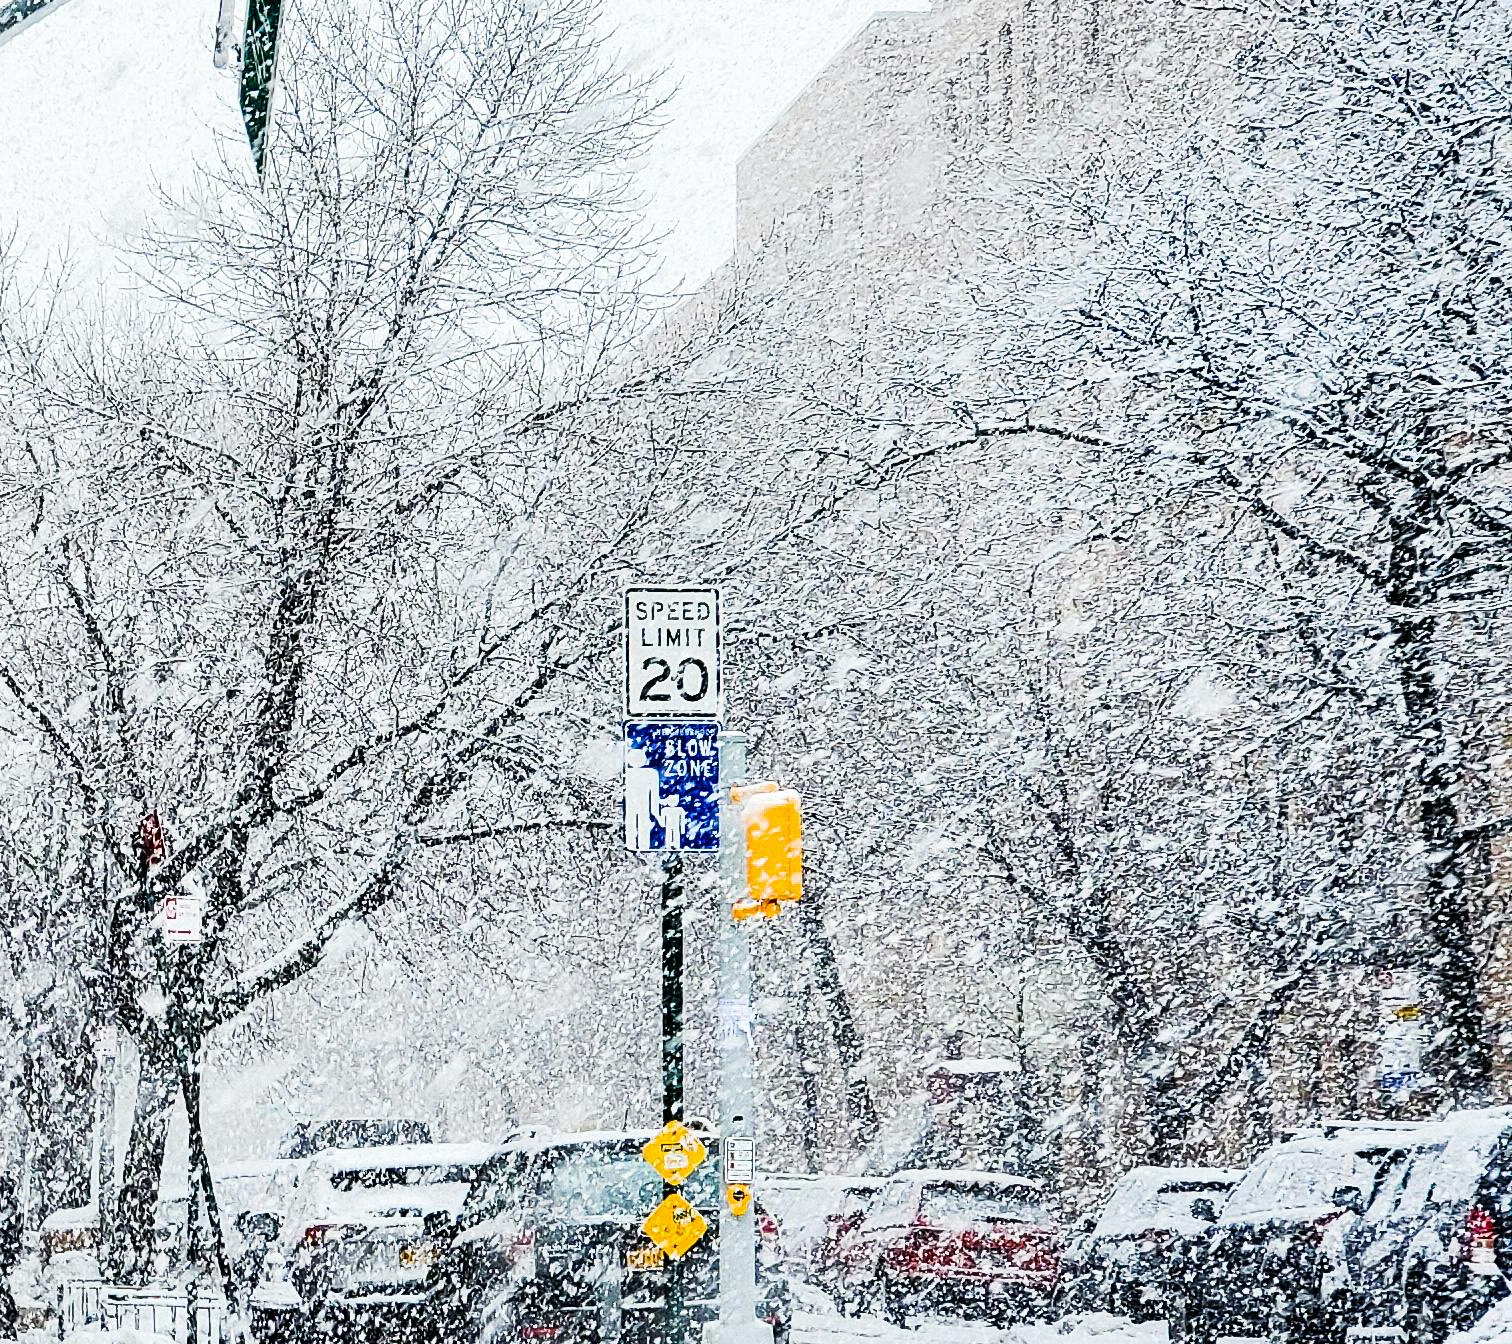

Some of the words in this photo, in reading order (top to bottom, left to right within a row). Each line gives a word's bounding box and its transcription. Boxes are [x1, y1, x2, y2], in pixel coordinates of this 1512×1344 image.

[636, 601, 710, 621] SPEED
[641, 627, 706, 647] LIMIT
[639, 656, 709, 702] 20
[664, 759, 714, 777] ZONE
